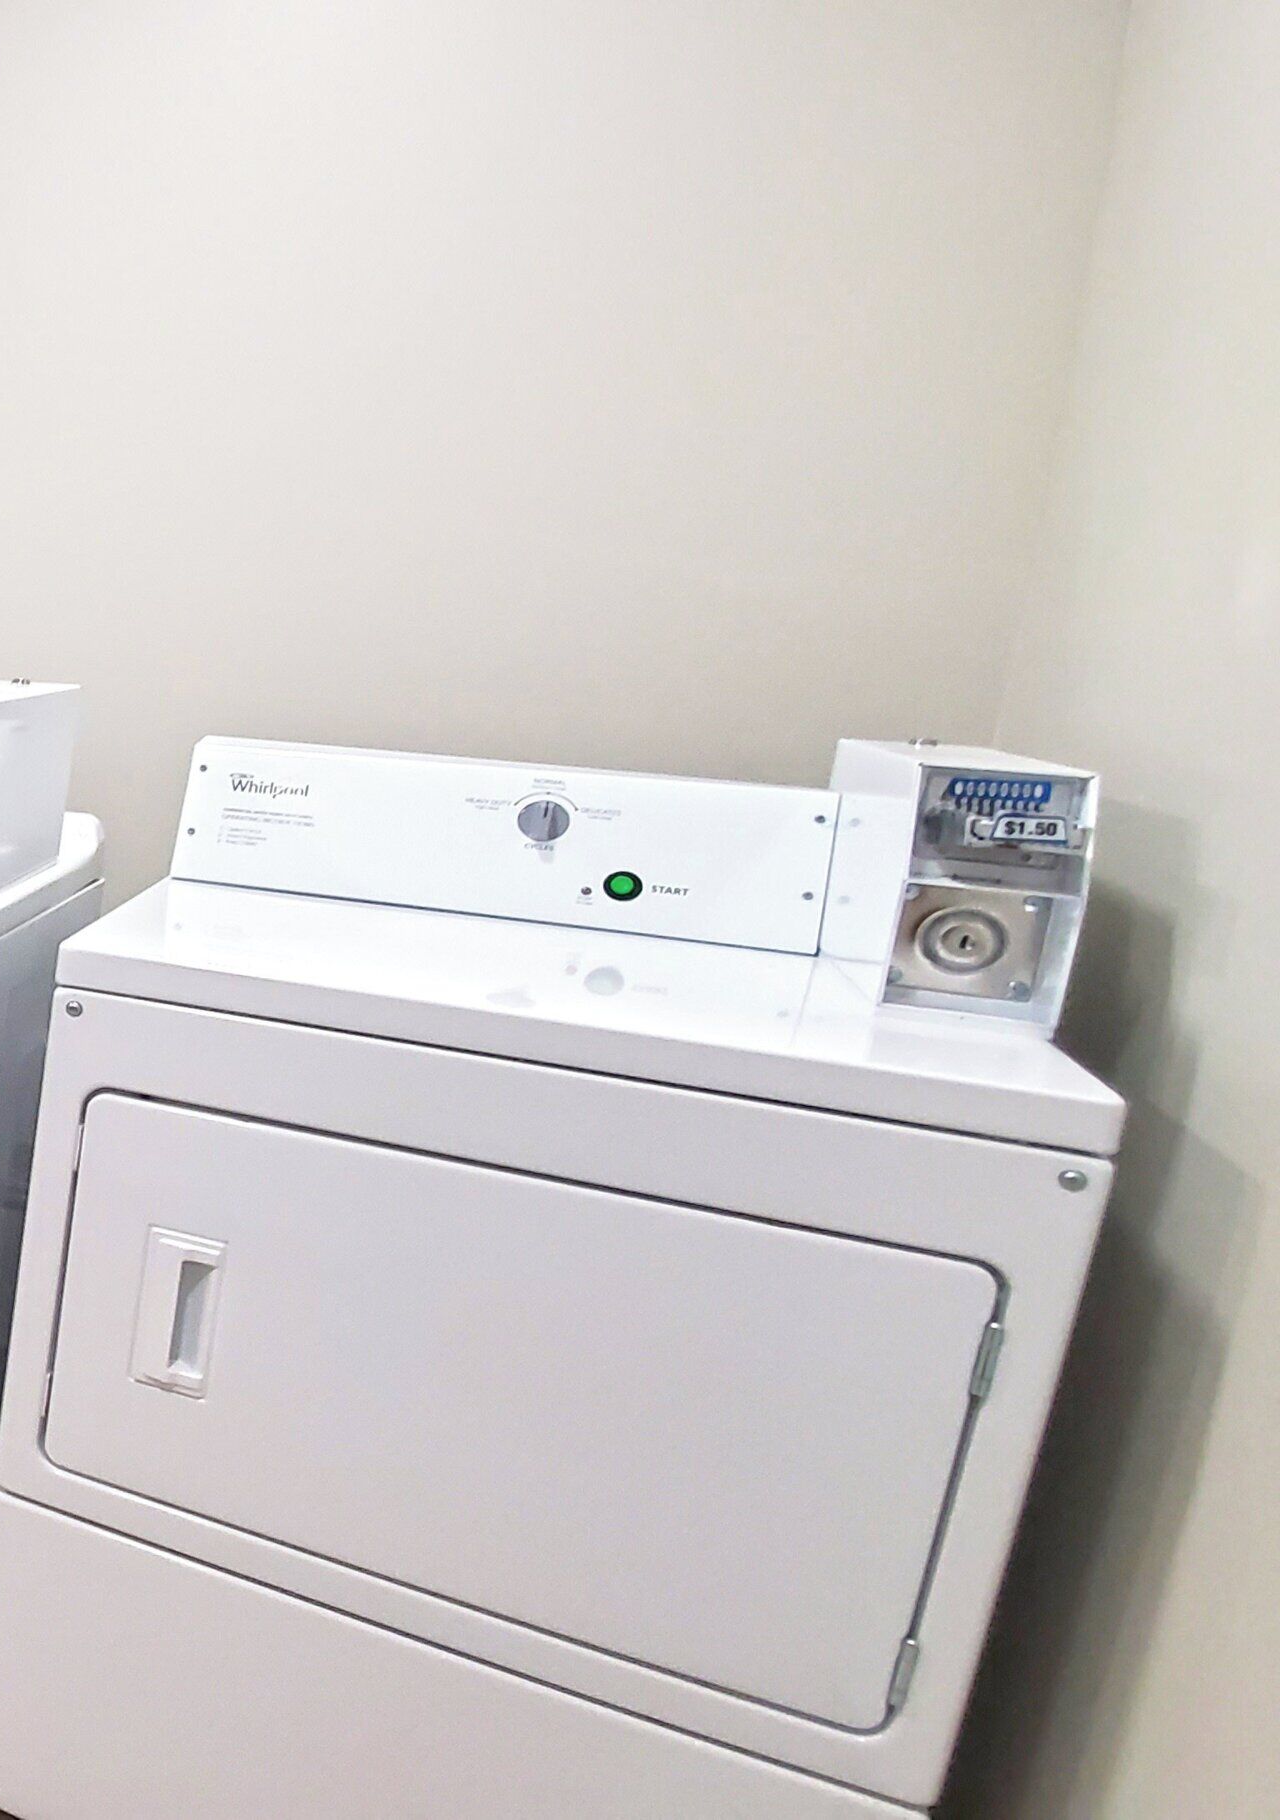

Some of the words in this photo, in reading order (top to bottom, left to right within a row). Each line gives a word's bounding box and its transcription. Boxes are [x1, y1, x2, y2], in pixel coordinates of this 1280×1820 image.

[231, 779, 309, 799] Whirlpool
[1004, 820, 1058, 837] $1.50
[651, 885, 689, 897] START
